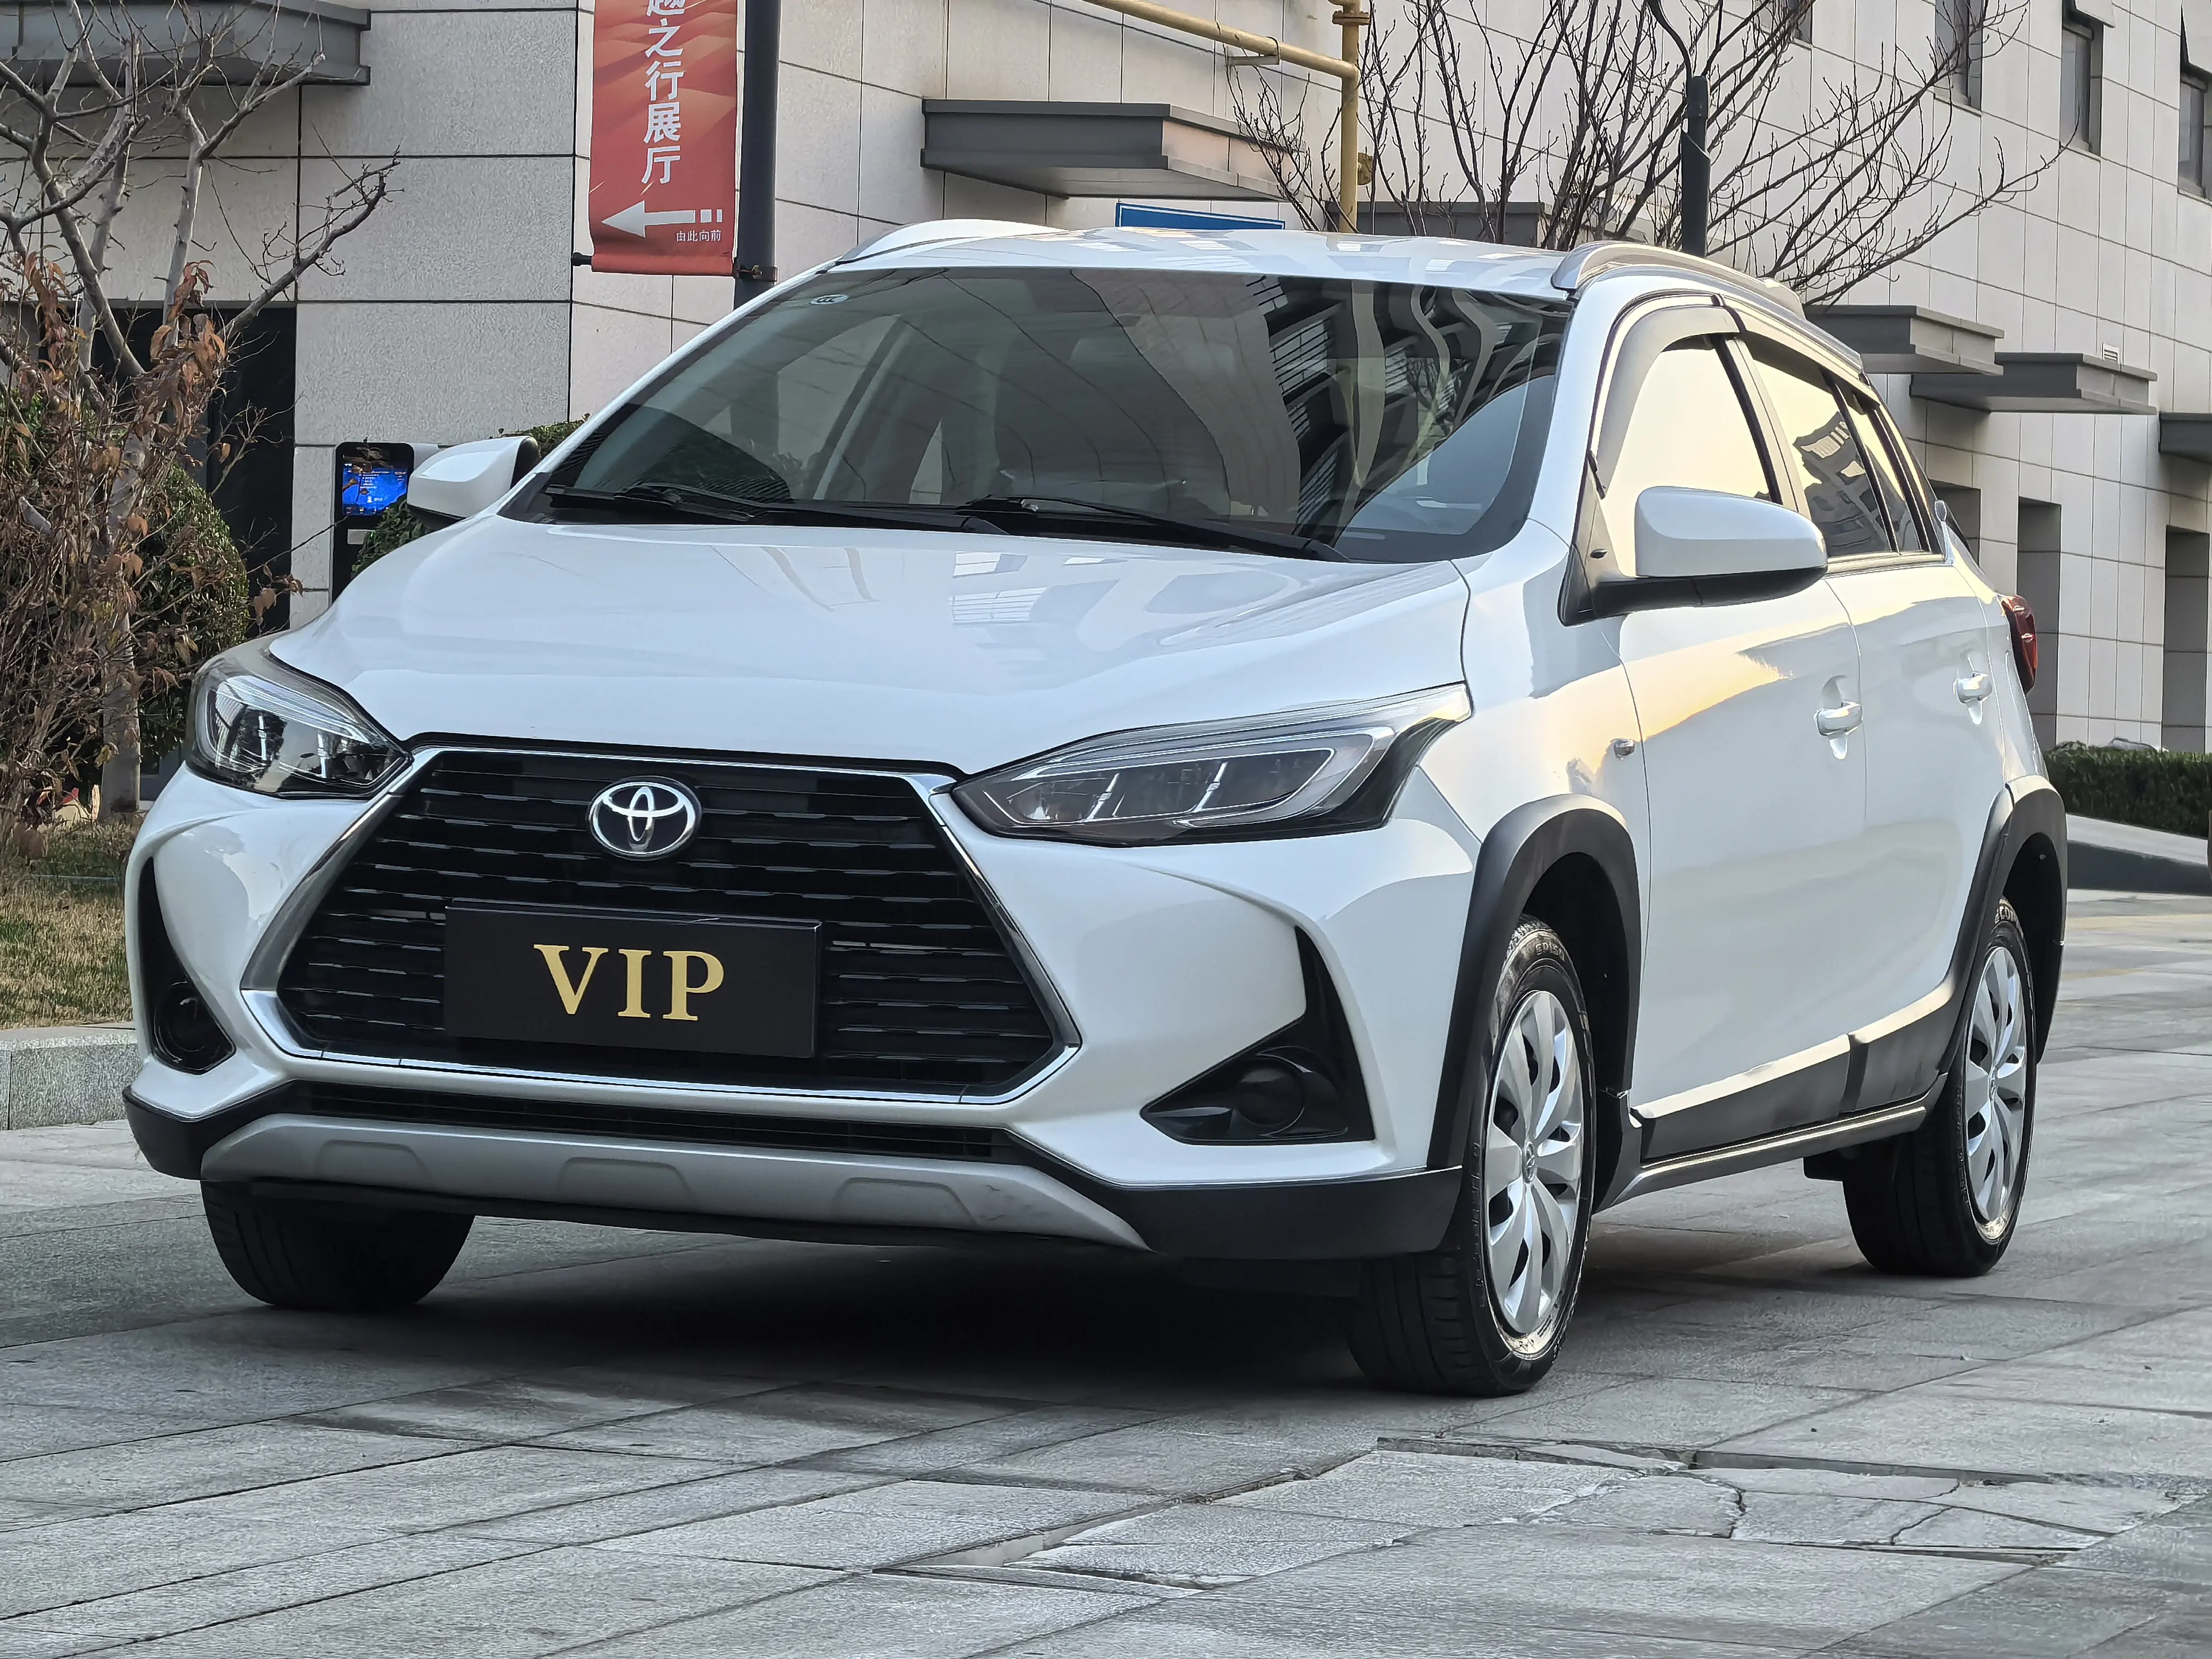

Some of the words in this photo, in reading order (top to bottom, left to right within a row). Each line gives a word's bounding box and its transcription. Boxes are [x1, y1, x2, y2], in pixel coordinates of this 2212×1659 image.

[676, 230, 721, 241] 由此向前
[534, 944, 724, 1021] VIP
